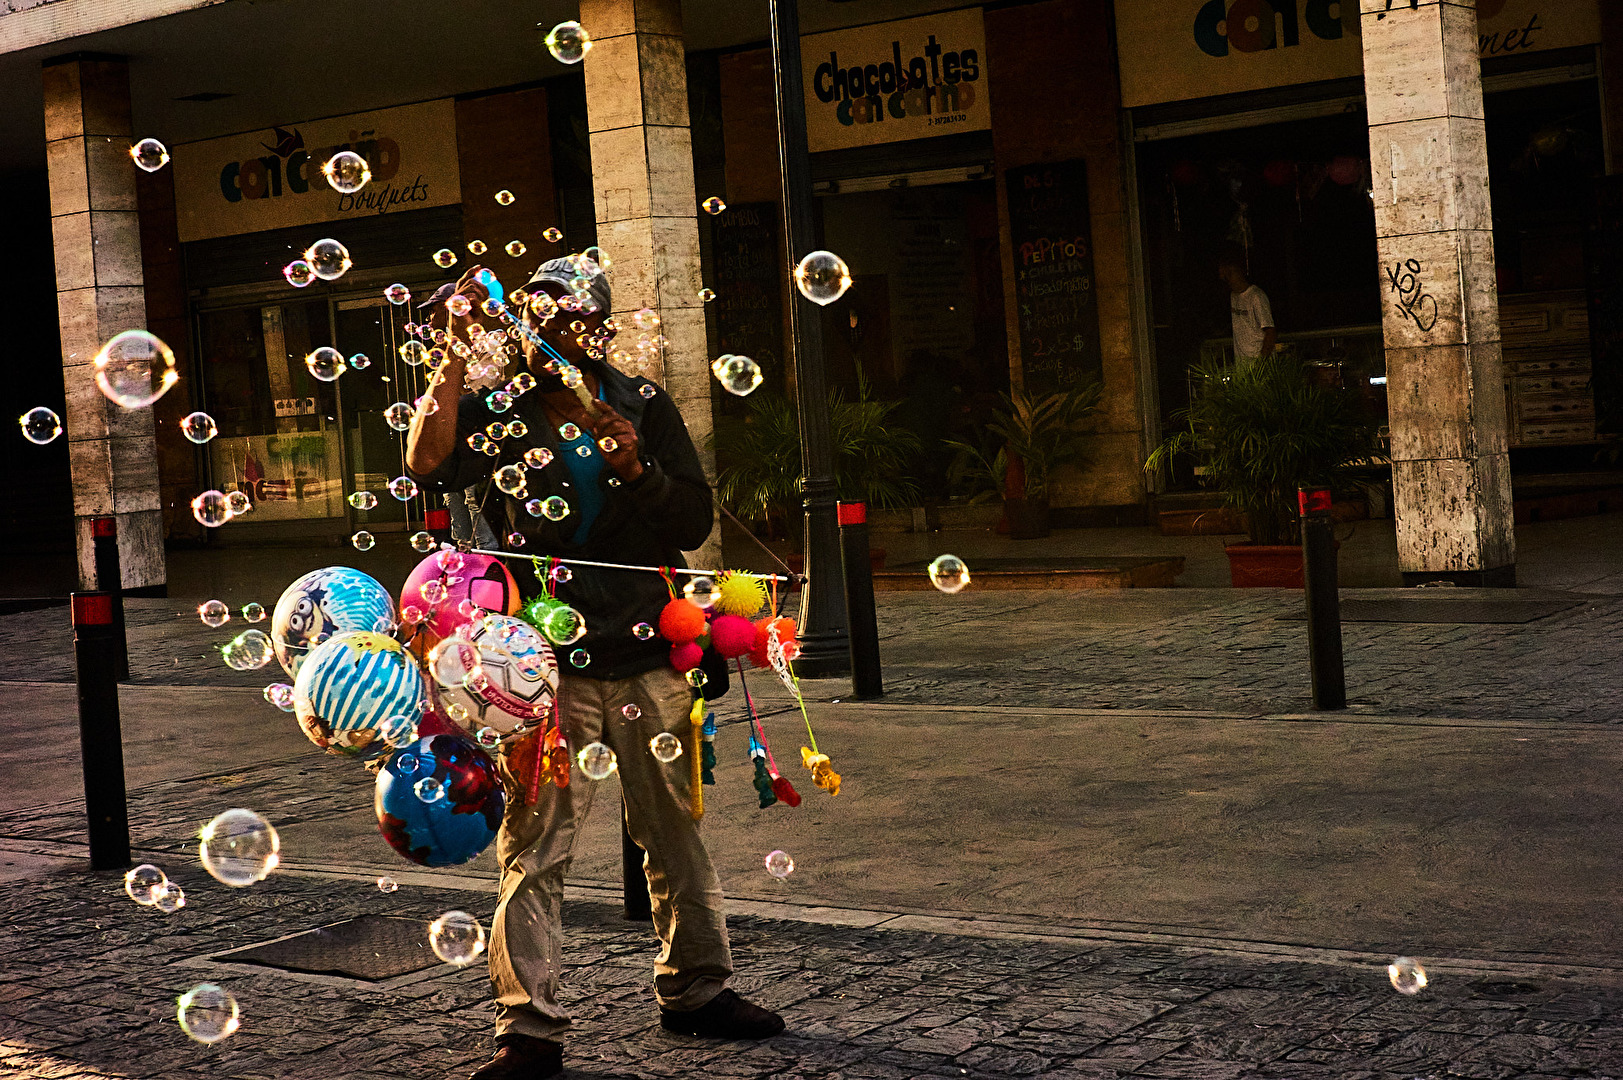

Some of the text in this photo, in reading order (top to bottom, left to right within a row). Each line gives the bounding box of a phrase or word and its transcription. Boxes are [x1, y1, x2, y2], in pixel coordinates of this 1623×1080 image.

[813, 34, 980, 103] Chocolates
[836, 94, 884, 126] con
[220, 154, 283, 203] con
[337, 174, 429, 215] Bouquets
